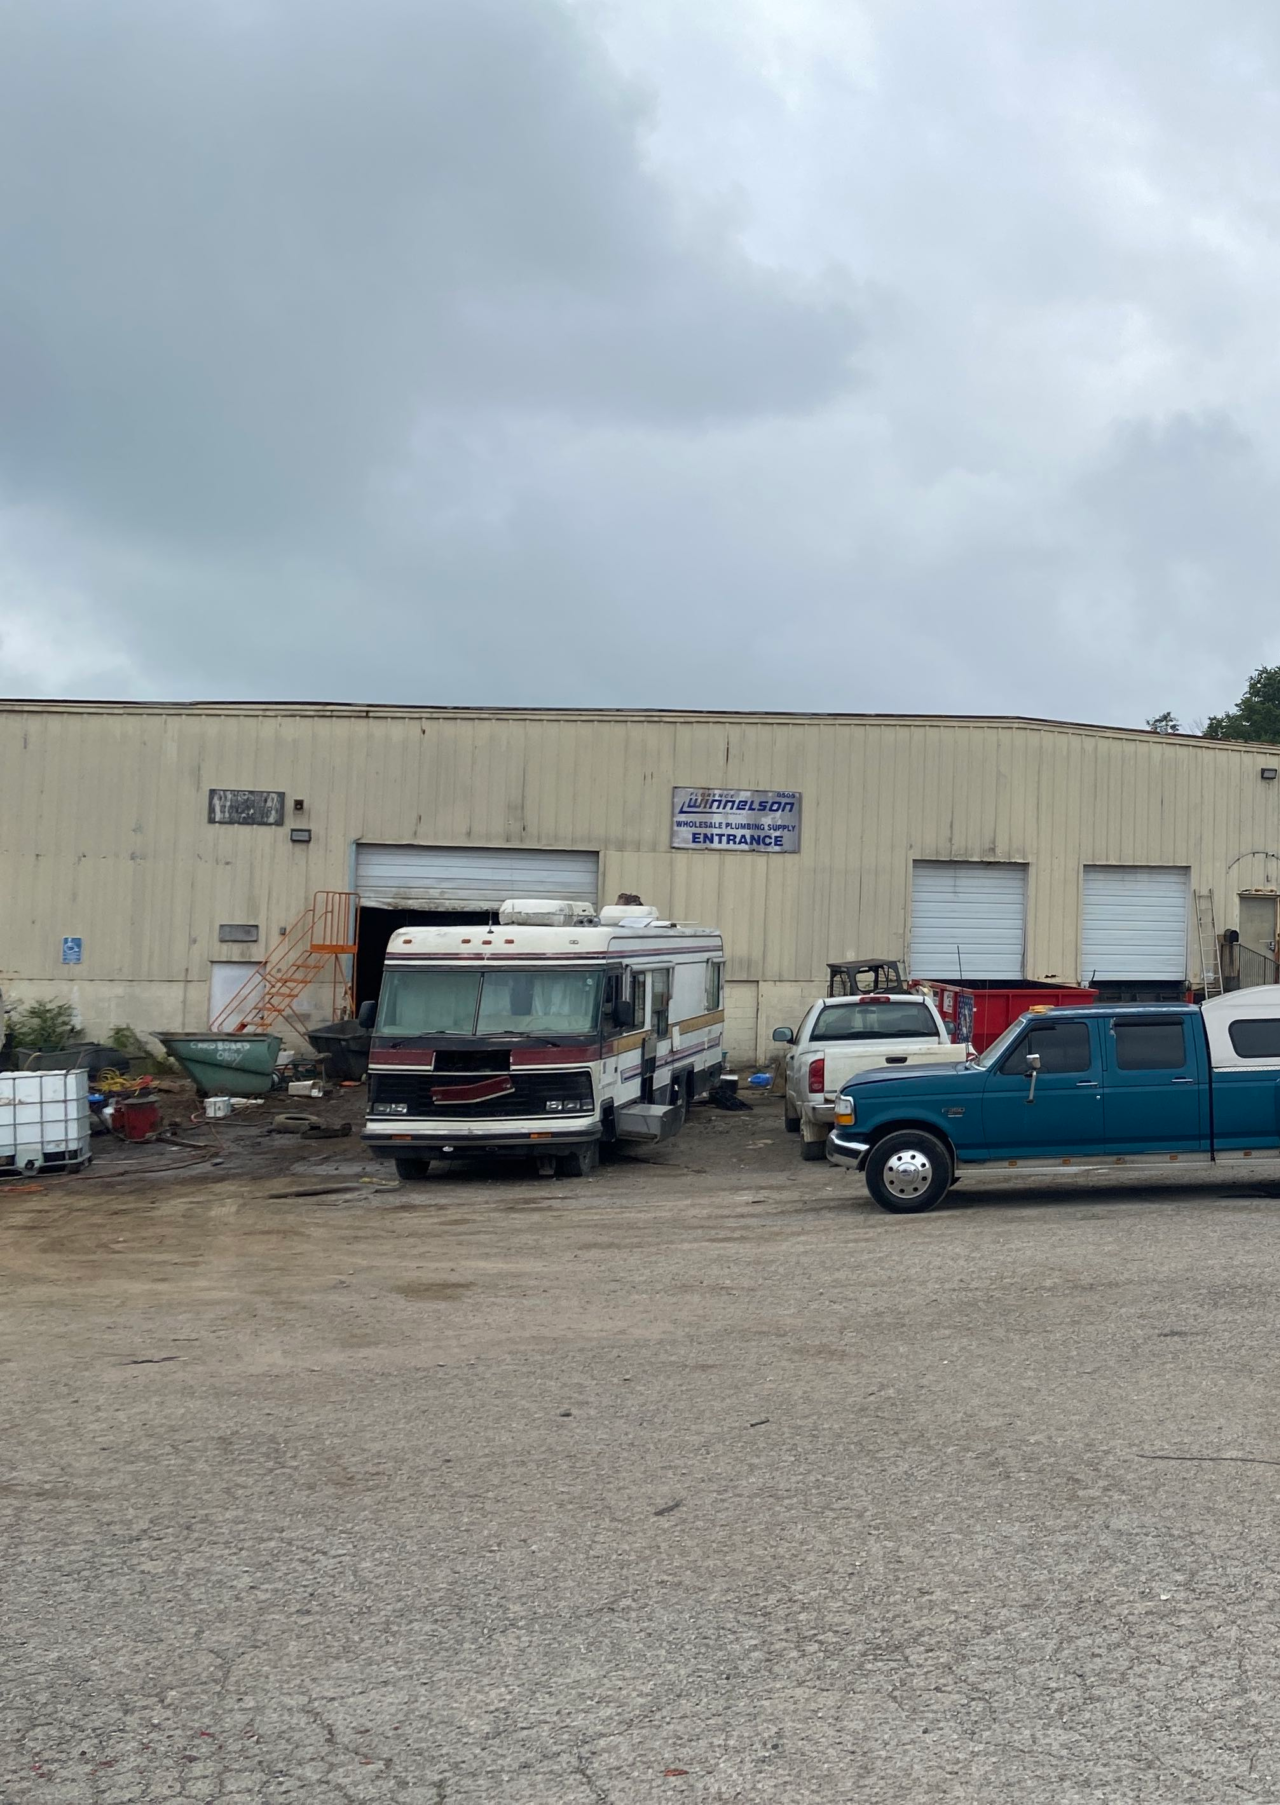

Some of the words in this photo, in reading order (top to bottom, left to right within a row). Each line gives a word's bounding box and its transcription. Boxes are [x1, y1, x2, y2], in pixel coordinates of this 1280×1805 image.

[675, 820, 723, 830] WHOLESALE
[725, 822, 765, 831] PLUMBING
[767, 824, 796, 832] SUPPLY
[691, 832, 784, 847] ENTRANCE
